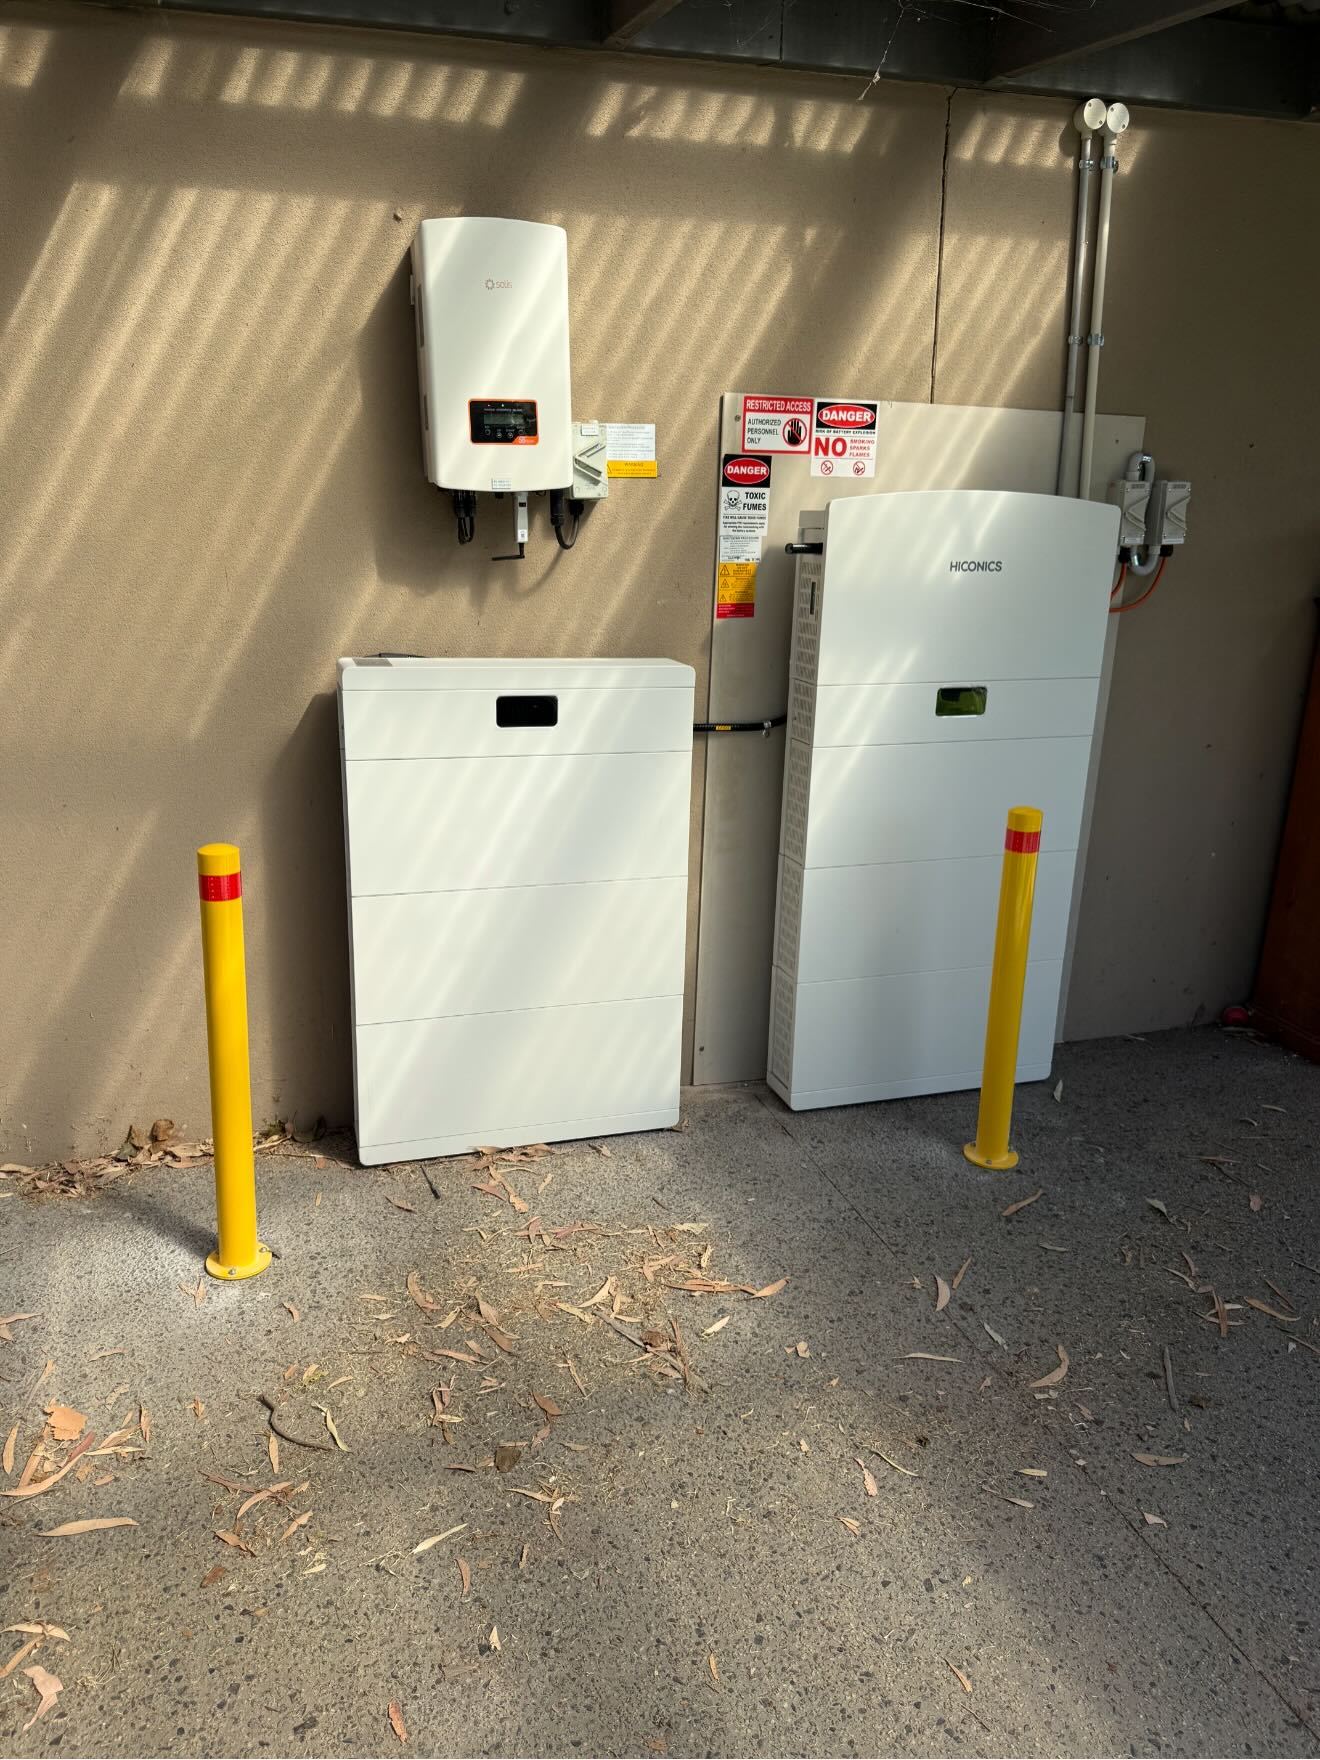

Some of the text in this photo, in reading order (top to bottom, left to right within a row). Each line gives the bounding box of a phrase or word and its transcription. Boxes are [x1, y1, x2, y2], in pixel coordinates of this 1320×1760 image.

[746, 399, 811, 412] RESTRICTED ACCESS
[822, 410, 871, 422] DANGER
[747, 418, 782, 426] AUTHORIZED
[746, 427, 779, 436] PERSONNEL
[746, 436, 761, 444] ONLY
[814, 436, 848, 457] NO
[727, 465, 768, 476] DANGER
[745, 491, 766, 500] TOXIC
[742, 503, 767, 511] FUMES
[949, 560, 1003, 573] HICONICS
